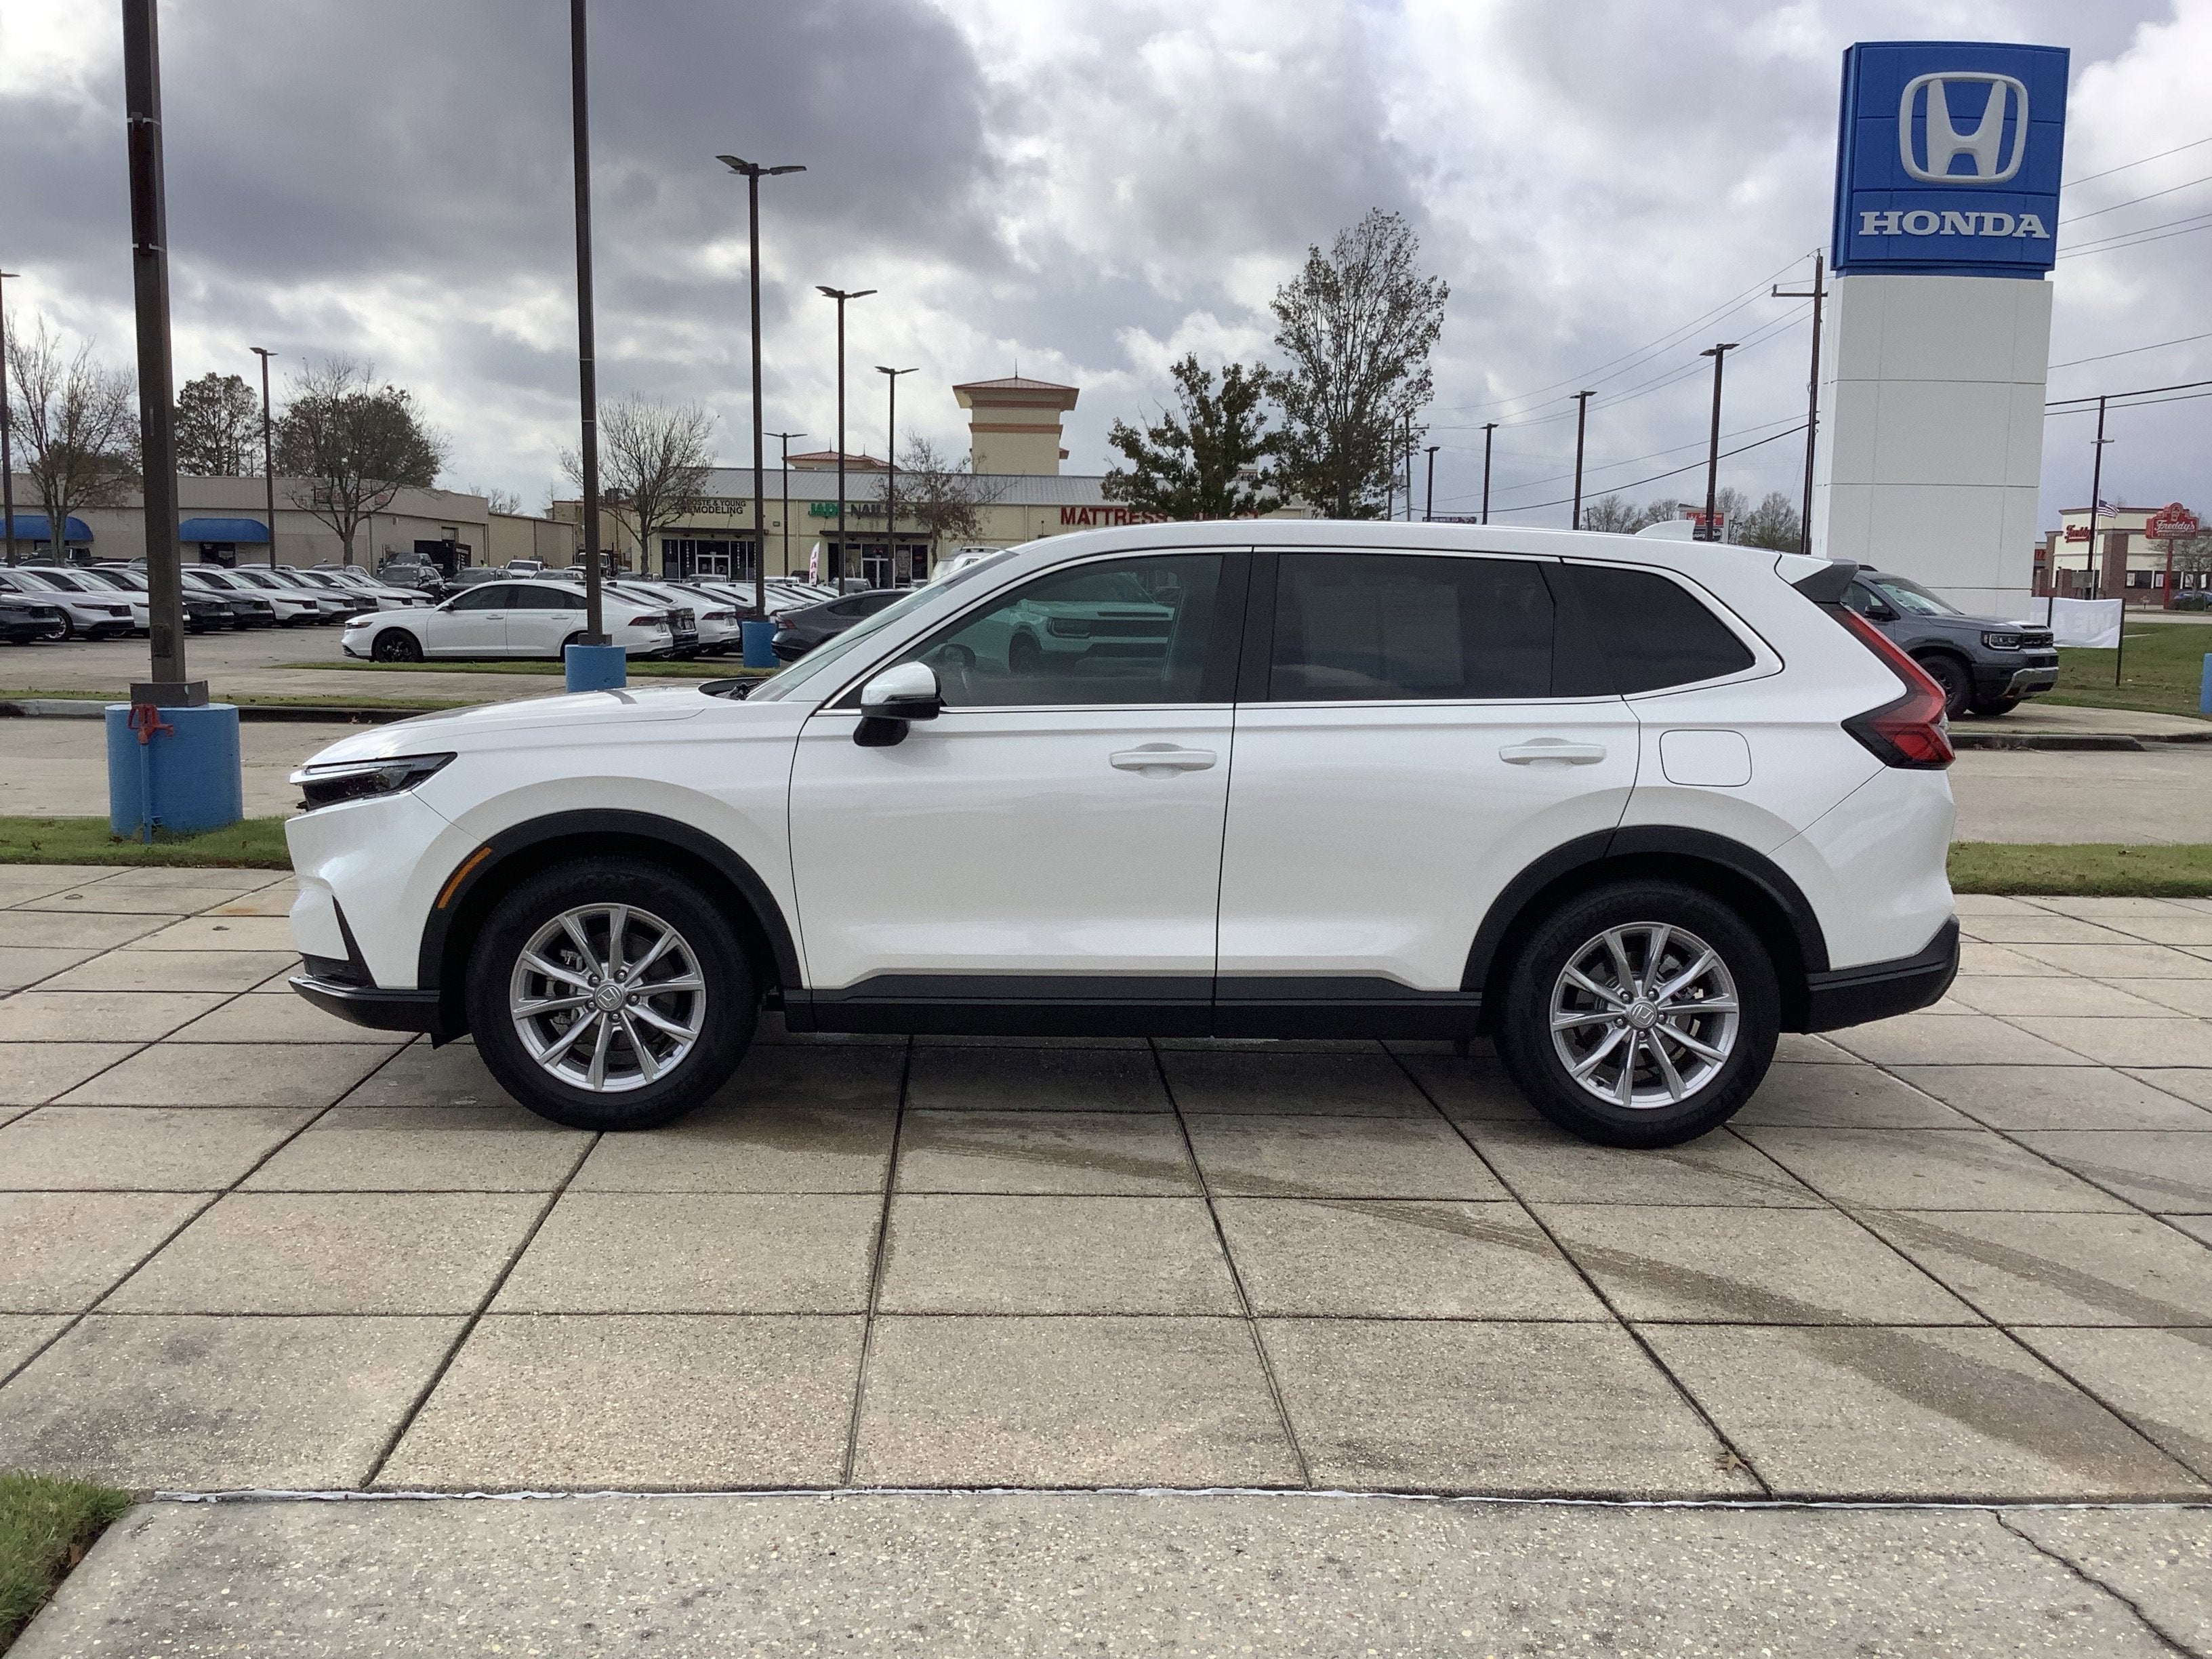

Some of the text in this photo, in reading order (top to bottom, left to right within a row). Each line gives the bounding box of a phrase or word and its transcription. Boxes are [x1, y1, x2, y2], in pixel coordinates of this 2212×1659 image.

[1858, 209, 2051, 239] HONDA
[1061, 507, 1168, 526] MATTRESS
[2154, 519, 2196, 532] Freddy's
